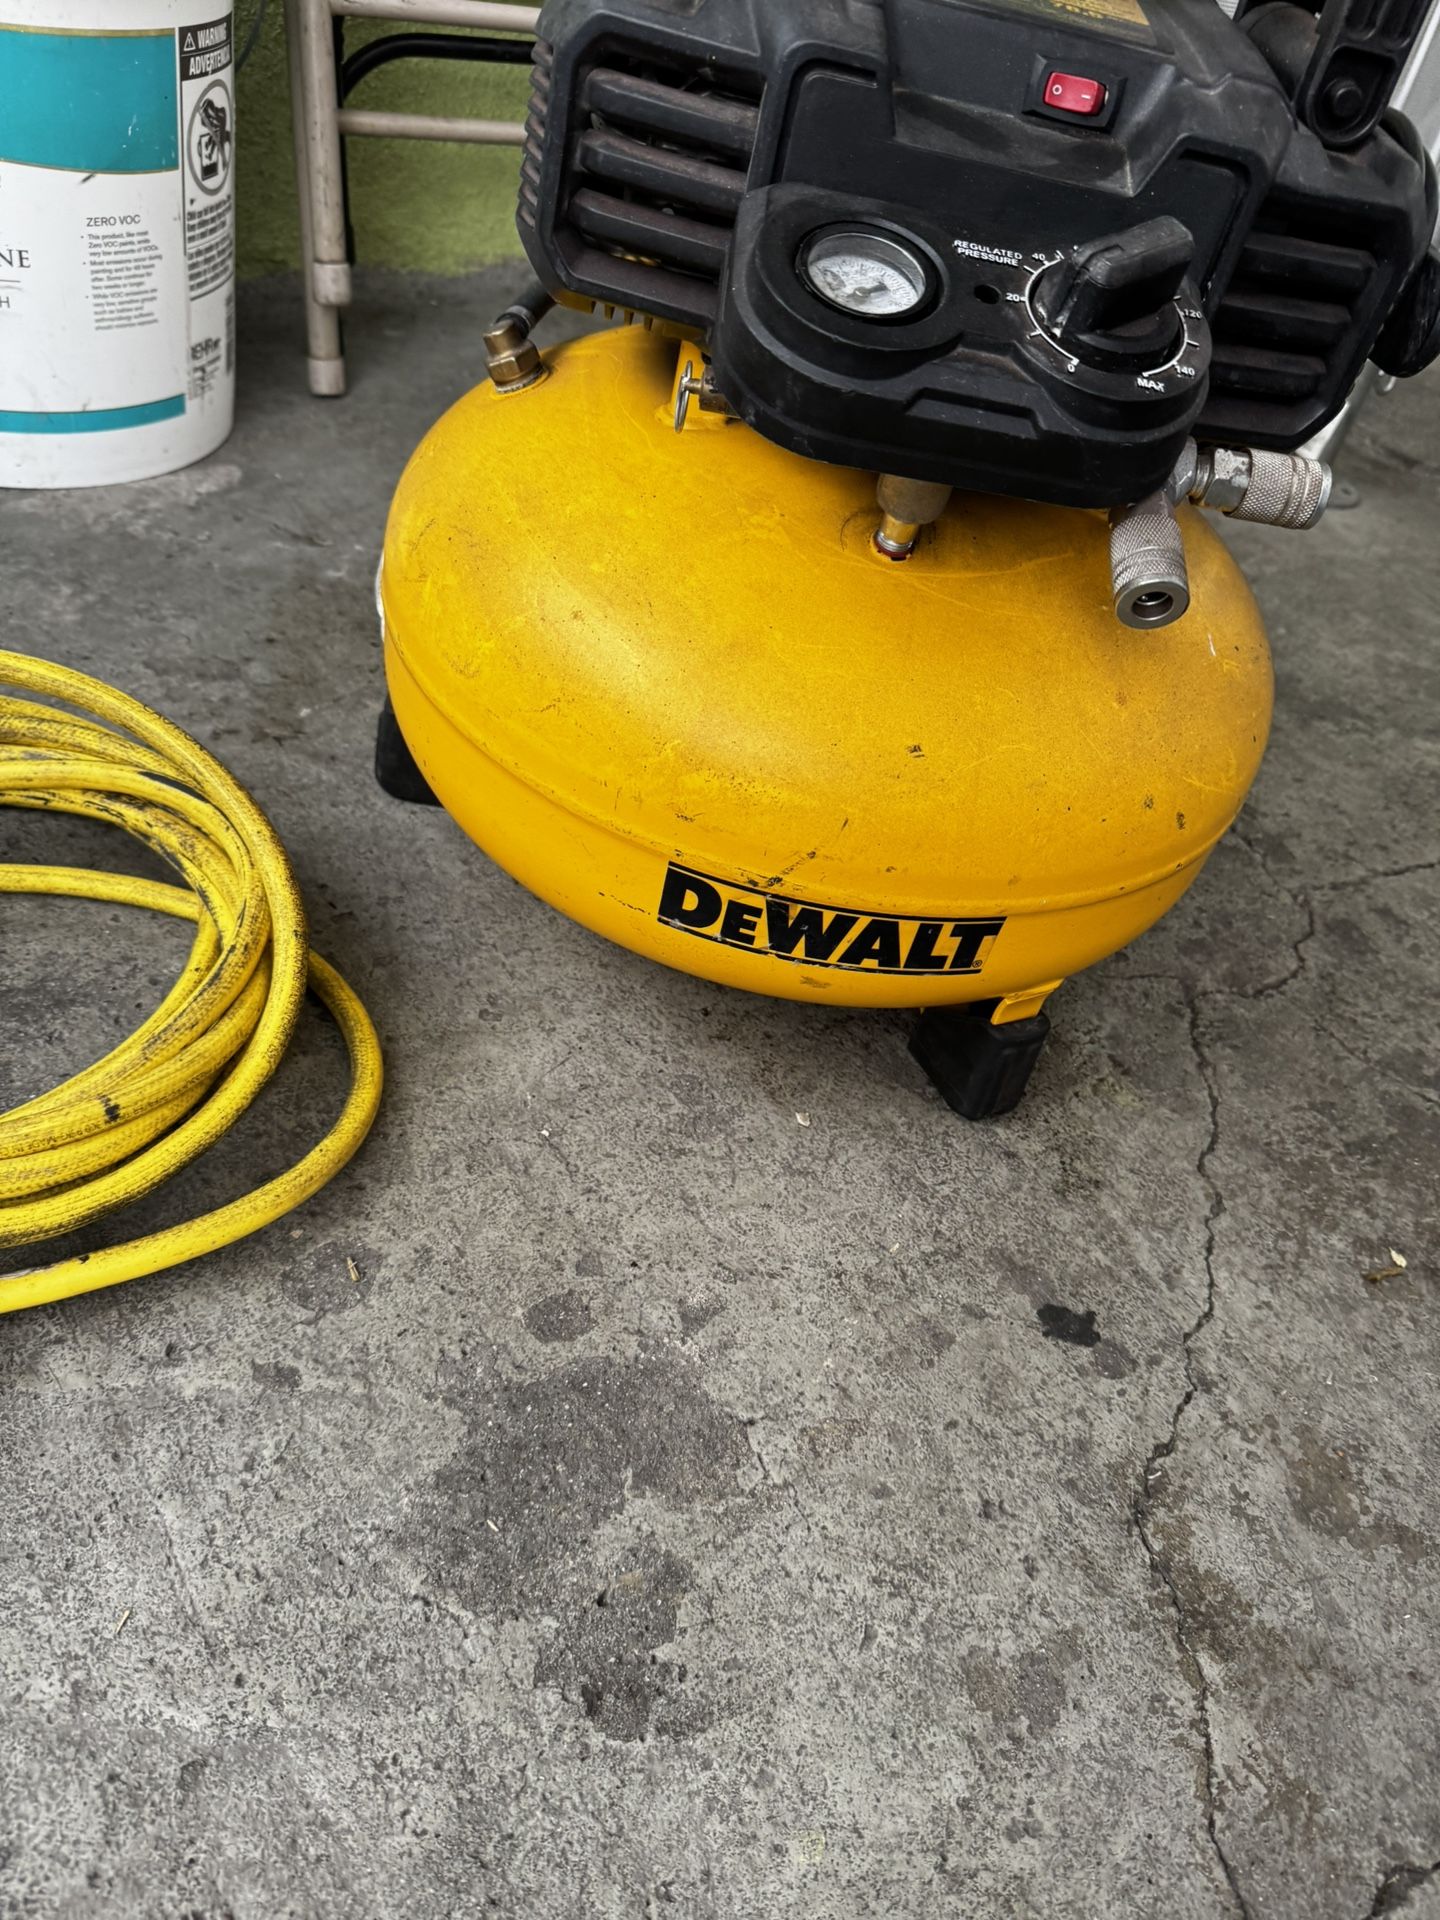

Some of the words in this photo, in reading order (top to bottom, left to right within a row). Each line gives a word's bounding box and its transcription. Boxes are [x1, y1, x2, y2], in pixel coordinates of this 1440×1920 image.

[86, 216, 117, 227] ZERO
[118, 214, 141, 225] VOC
[88, 241, 102, 249] Zero
[103, 240, 119, 248] VOC
[953, 239, 1023, 260] REGULATED
[957, 247, 1019, 267] PRESSURE
[1031, 252, 1046, 261] 40
[1005, 292, 1020, 301] 20
[1183, 308, 1202, 319] 120
[1067, 363, 1076, 373] 0
[1175, 364, 1195, 376] 140
[1137, 377, 1165, 393] MAX
